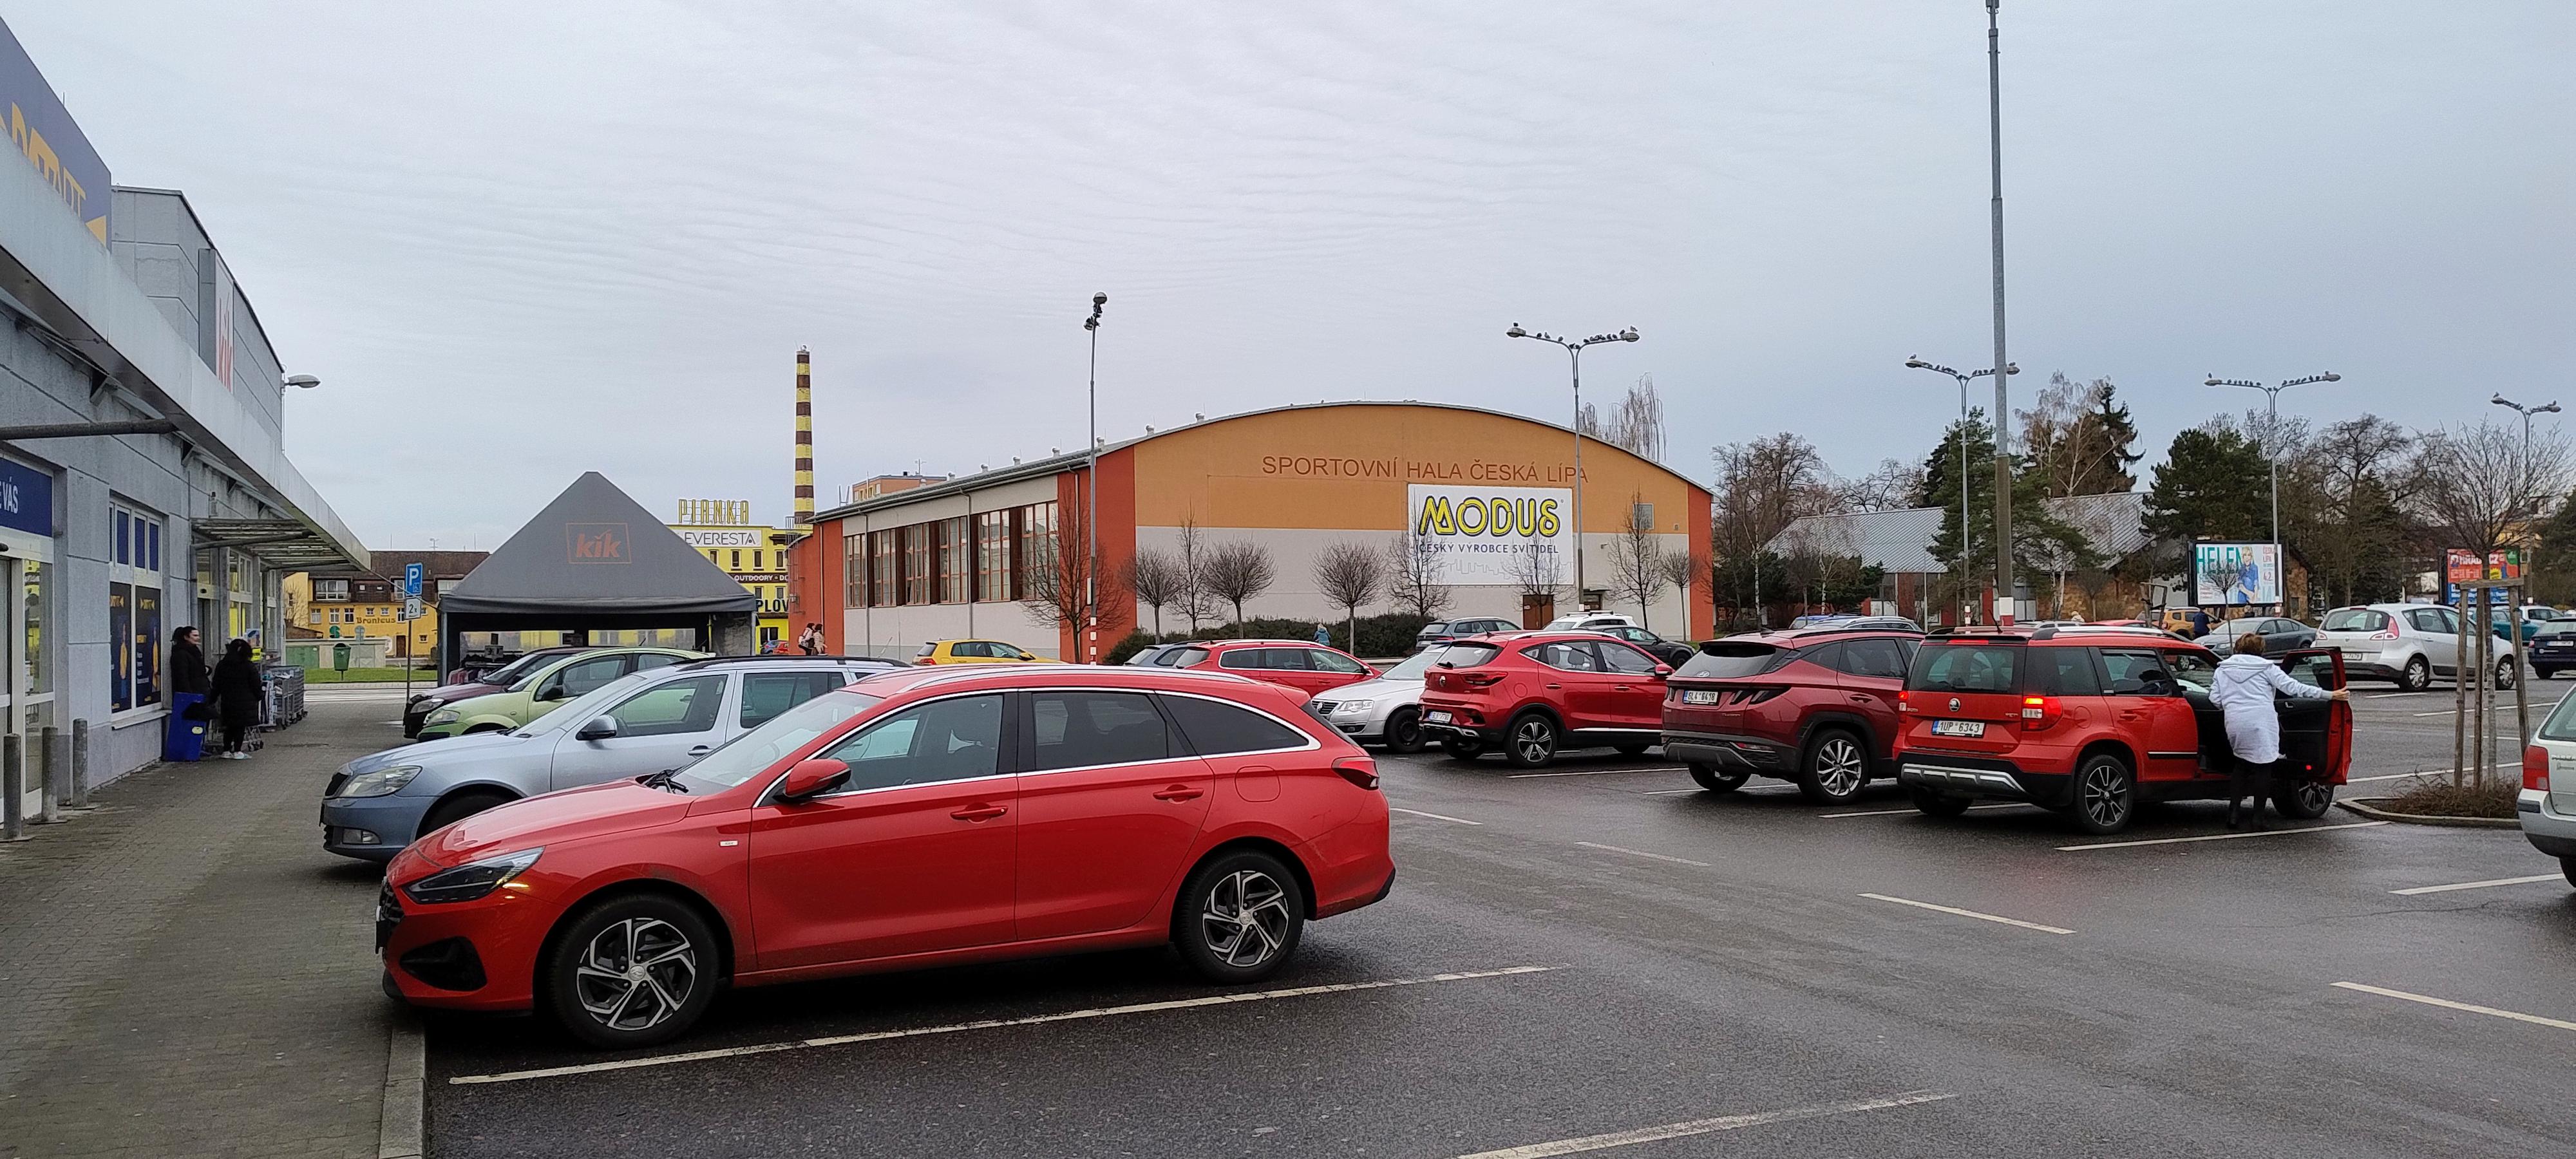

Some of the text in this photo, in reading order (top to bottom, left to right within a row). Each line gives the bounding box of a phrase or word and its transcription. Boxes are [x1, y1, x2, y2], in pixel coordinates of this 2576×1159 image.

[1262, 456, 1589, 483] SPORTOVNÍ HALA ČESKÁ LÍPA
[3, 476, 19, 514] VÁS
[678, 499, 749, 524] PIANKA
[1418, 495, 1560, 537] MODUS
[576, 529, 621, 558] kik
[685, 532, 755, 545] EVERESTA
[1459, 542, 1509, 553] VÝROBCE
[409, 568, 419, 586] P
[1940, 722, 1980, 733] 1UP 6343
